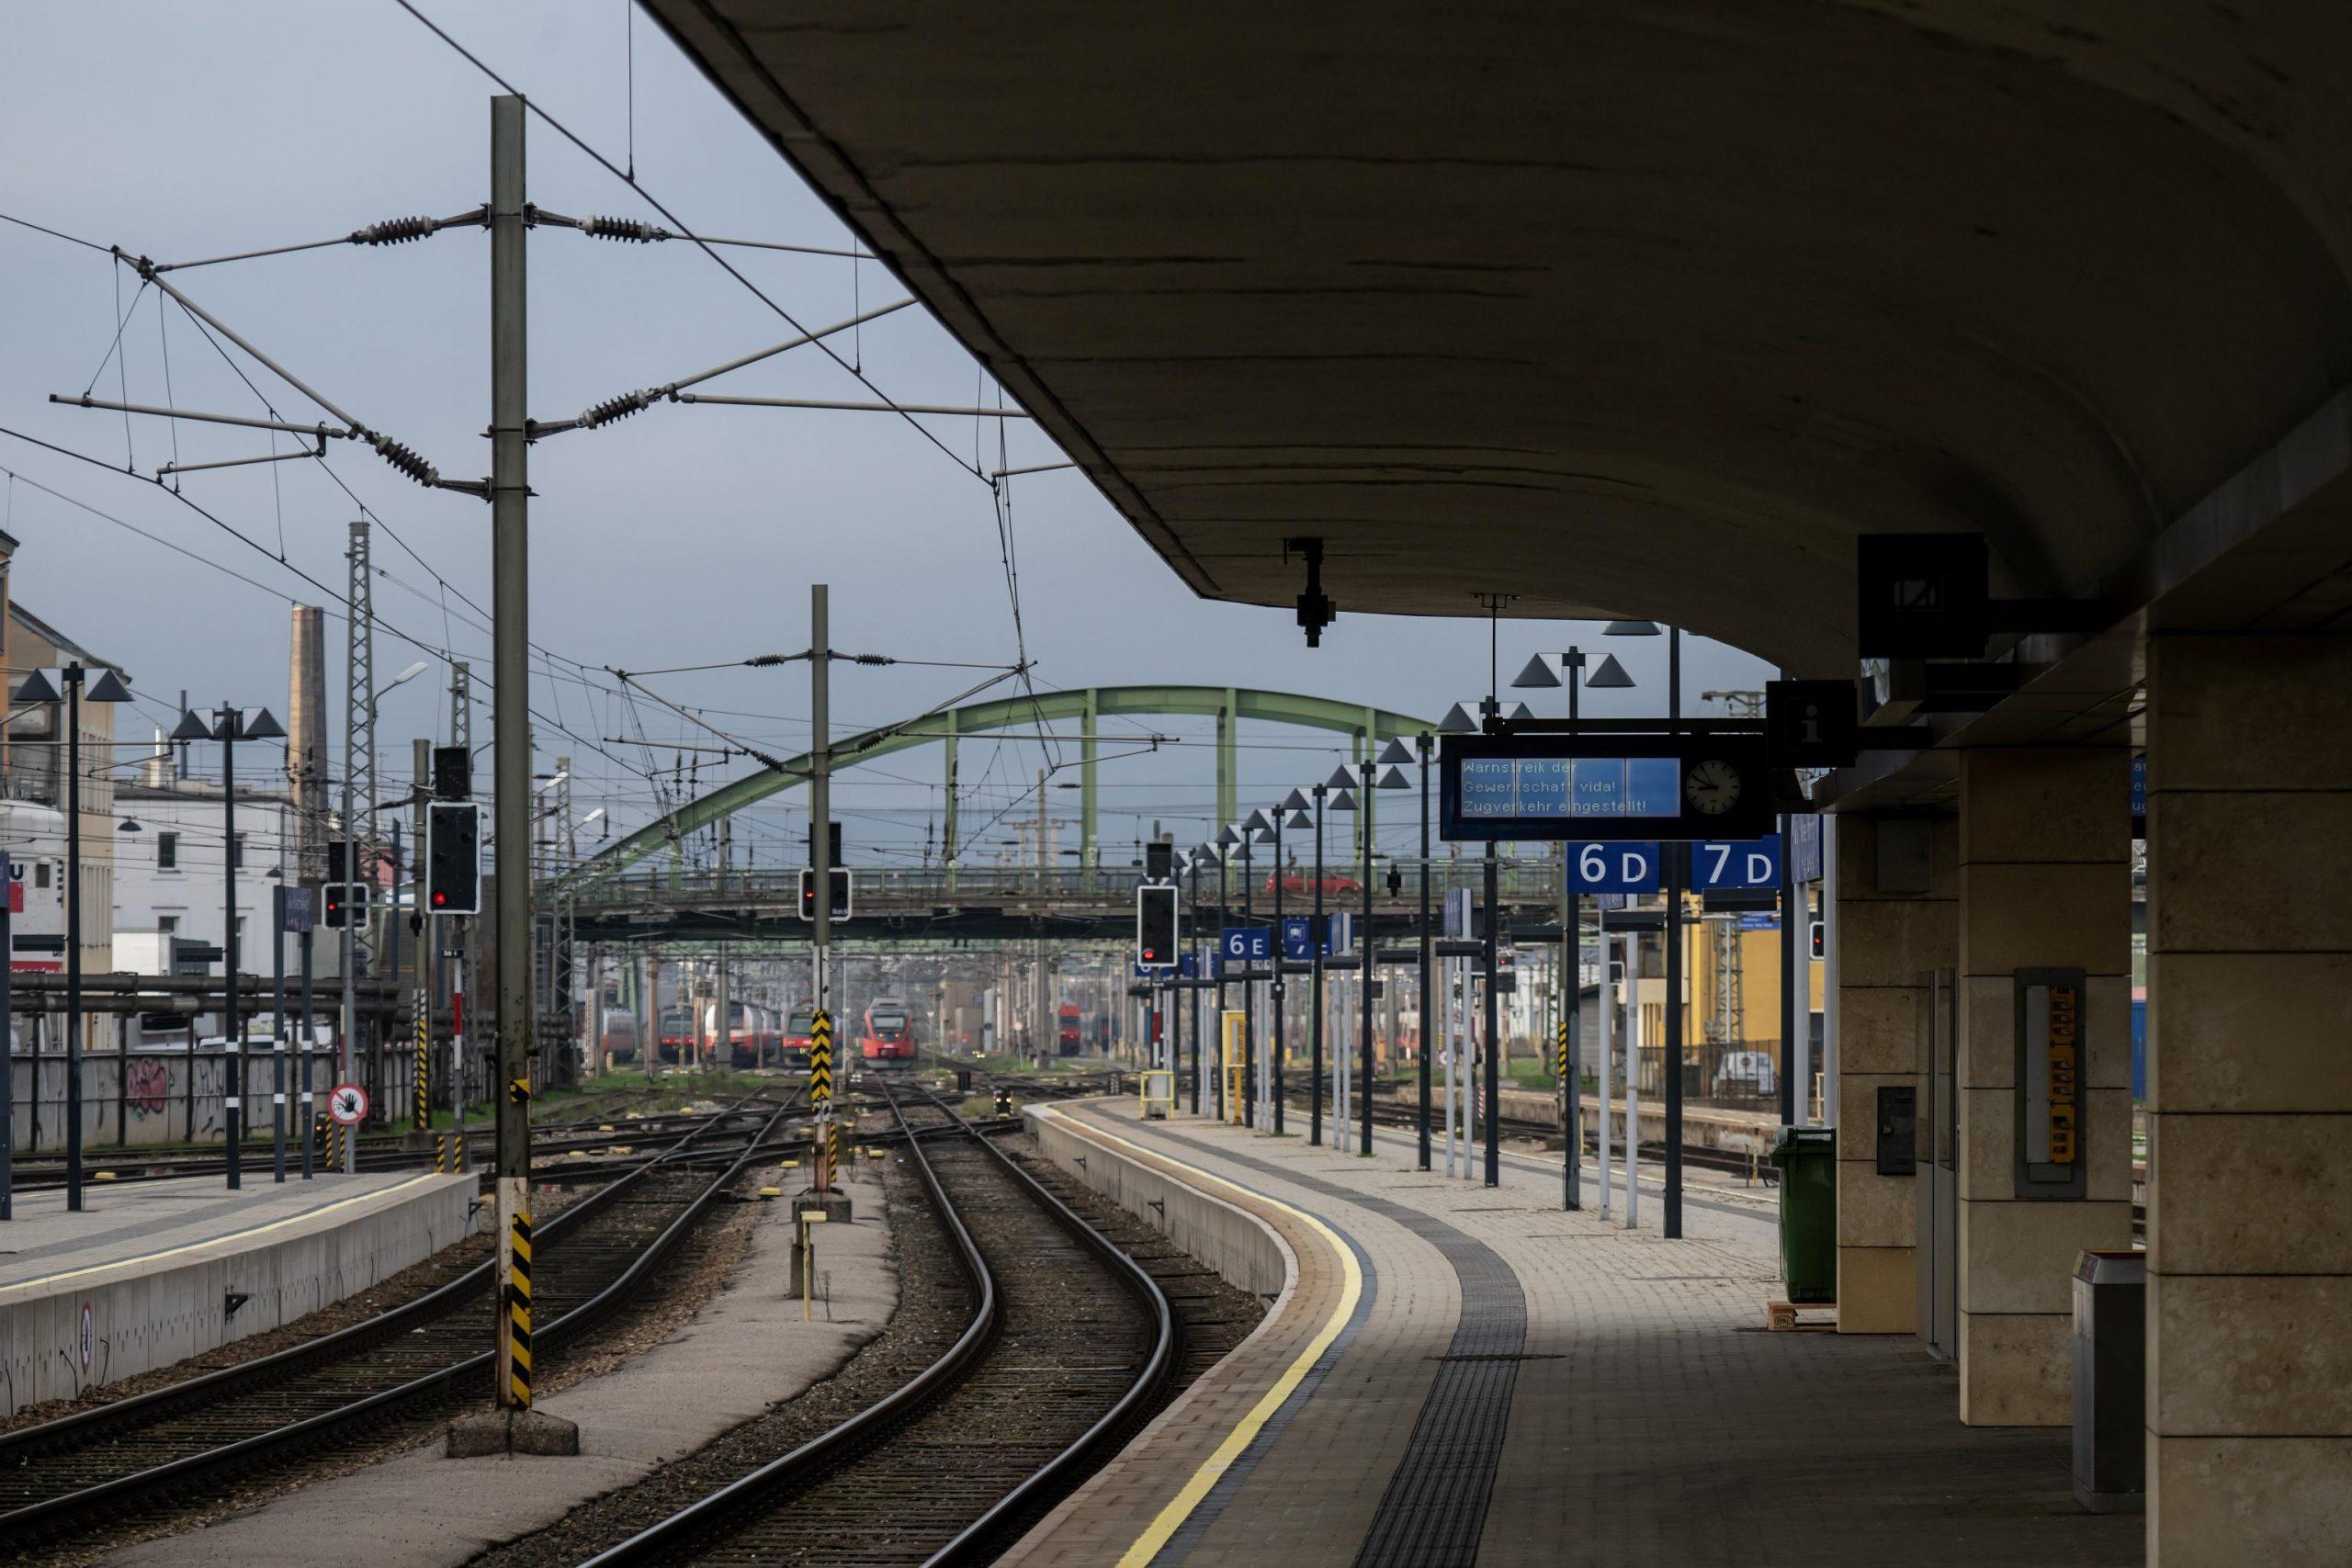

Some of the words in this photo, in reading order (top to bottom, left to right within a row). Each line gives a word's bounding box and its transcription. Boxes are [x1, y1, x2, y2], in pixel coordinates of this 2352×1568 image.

[1463, 761, 1545, 773] Warnstreik
[1552, 761, 1577, 773] der
[1463, 781, 1571, 793] Gewerkschaft
[1579, 781, 1615, 793] vida!
[1463, 800, 1552, 814] Zugverkehr
[1558, 800, 1646, 814] eingestellt!
[1579, 843, 1607, 883] 6
[1622, 852, 1647, 883] D
[1704, 844, 1731, 884] 7
[1747, 853, 1772, 884] D
[1229, 933, 1245, 955] 6
[1252, 938, 1263, 955] E
